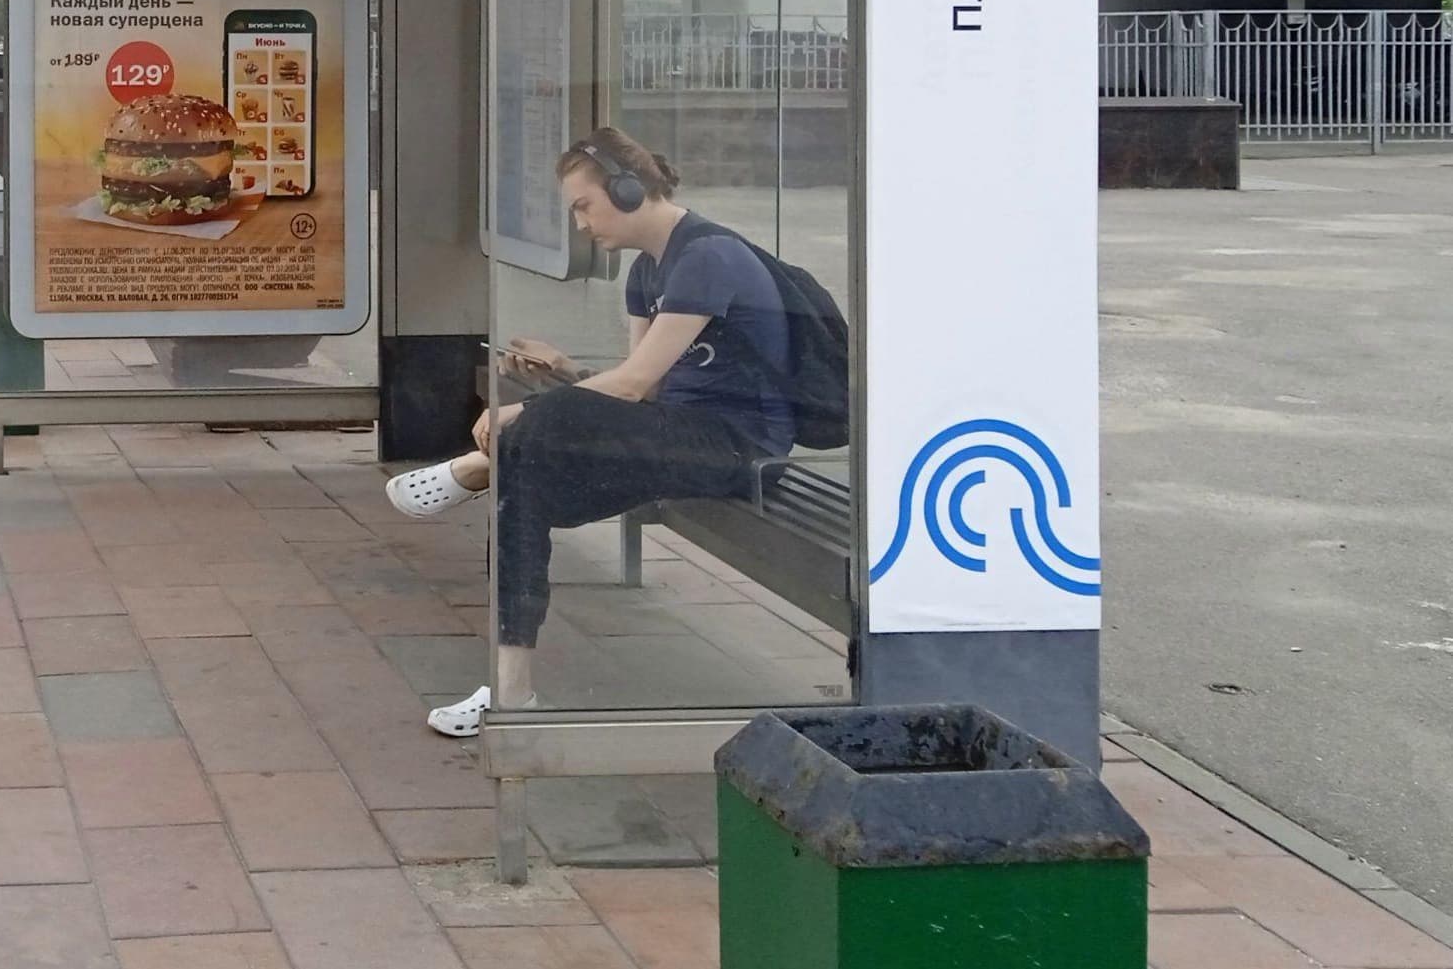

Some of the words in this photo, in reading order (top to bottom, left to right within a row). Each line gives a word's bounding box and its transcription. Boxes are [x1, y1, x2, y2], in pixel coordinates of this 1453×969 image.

[50, 15, 104, 27] новая
[108, 15, 204, 30] суперцена
[255, 37, 286, 47] Июнь
[50, 57, 62, 67] от
[296, 220, 313, 233] 12+
